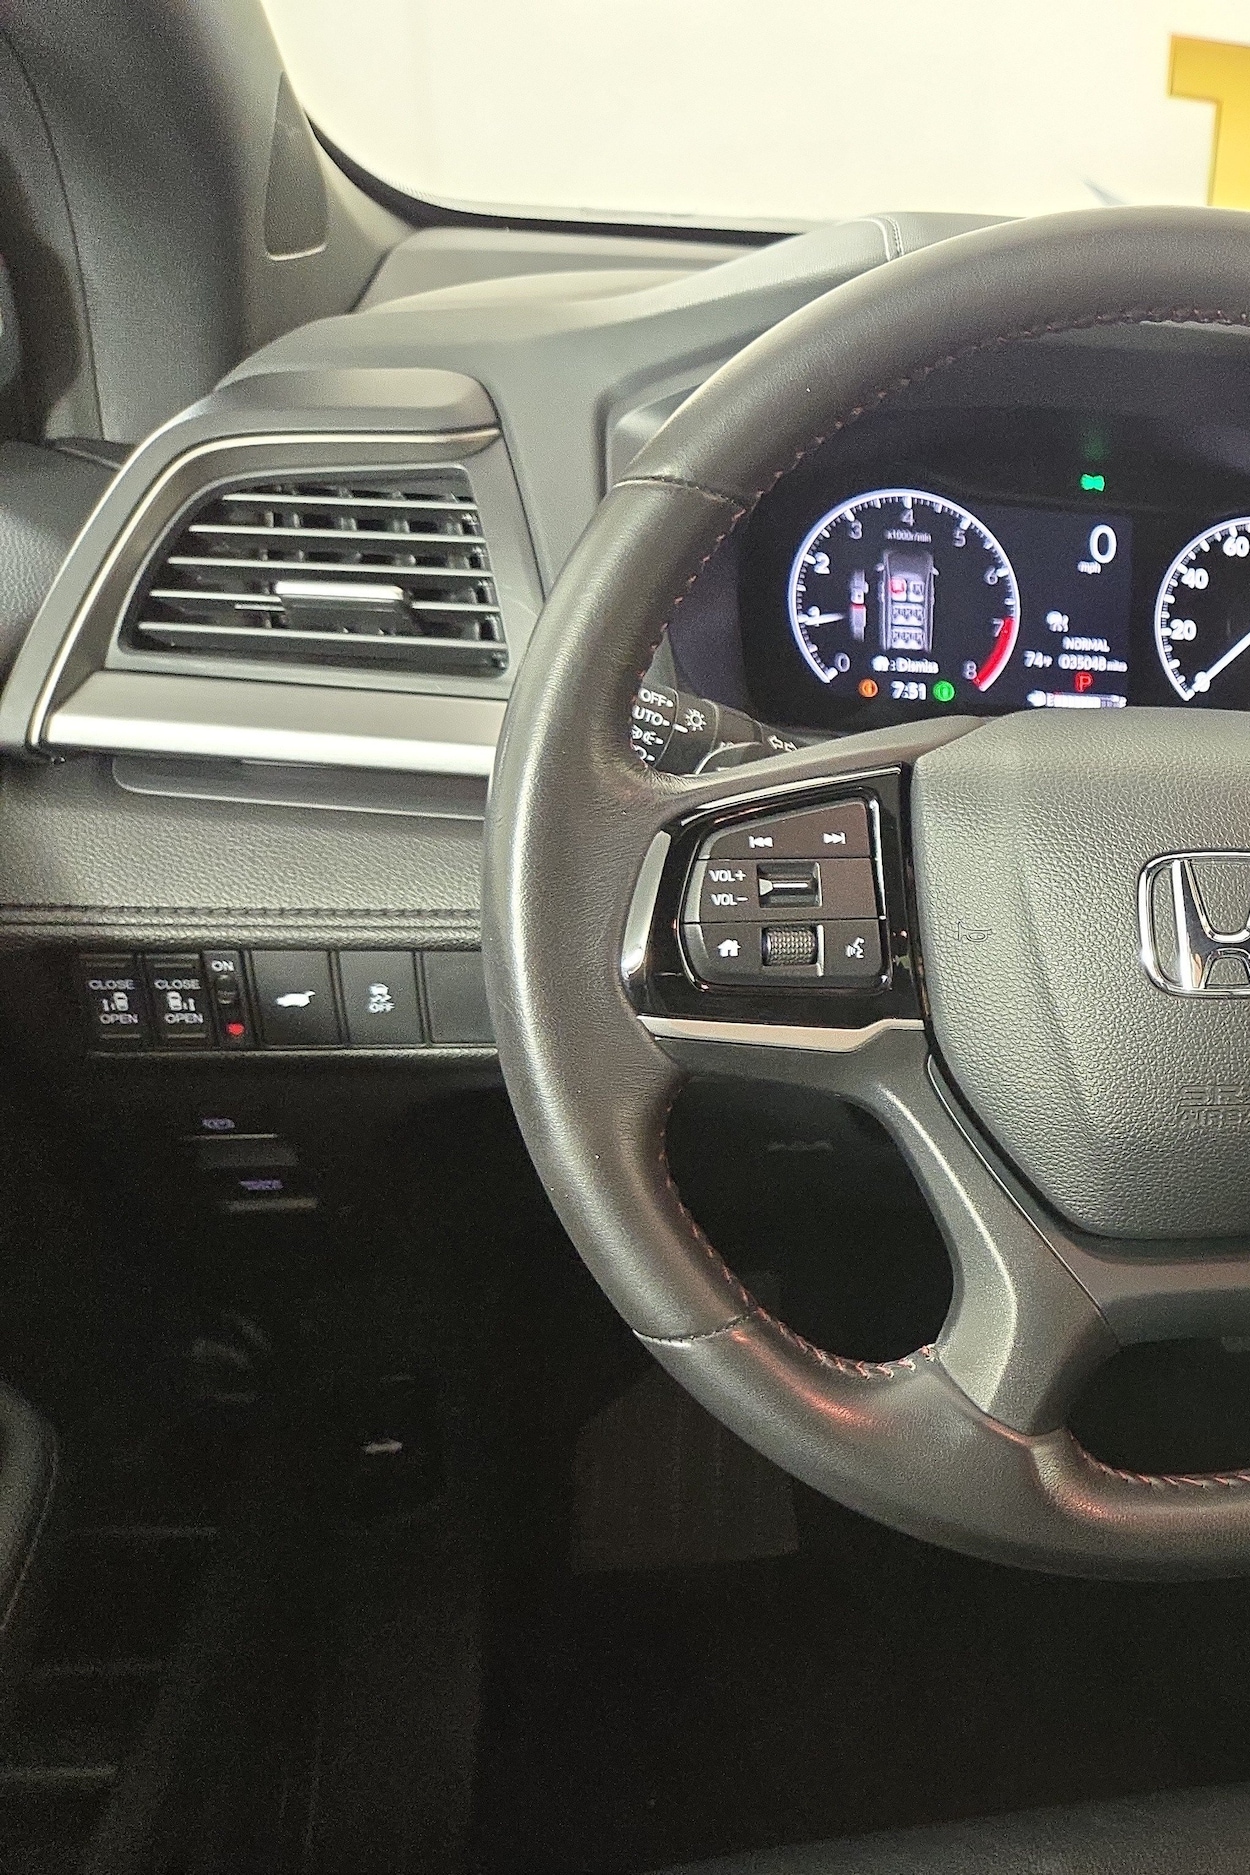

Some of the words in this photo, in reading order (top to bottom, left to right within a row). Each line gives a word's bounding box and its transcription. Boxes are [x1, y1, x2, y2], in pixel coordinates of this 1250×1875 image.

[901, 508, 915, 526] 4
[849, 520, 863, 539] 3
[953, 530, 967, 547] 5
[1089, 524, 1117, 564] 0
[1222, 537, 1250, 558] 60
[813, 551, 831, 574] 2
[983, 566, 999, 585] 6
[1181, 567, 1209, 590] 40
[1169, 618, 1198, 641] 20
[1062, 635, 1110, 653] NORMAL
[833, 652, 850, 672] 0
[962, 660, 977, 680] 8
[890, 680, 927, 701] 7:51
[1074, 671, 1093, 692] P
[637, 687, 667, 707] OFF
[631, 704, 664, 727] UTO
[708, 869, 747, 883] VOL+
[211, 959, 235, 973] ON
[87, 978, 135, 991] CLOSE
[154, 978, 201, 991] CLOSE
[367, 1002, 395, 1014] OFF
[100, 1012, 139, 1025] OPEN
[164, 1012, 204, 1025] OPEN
